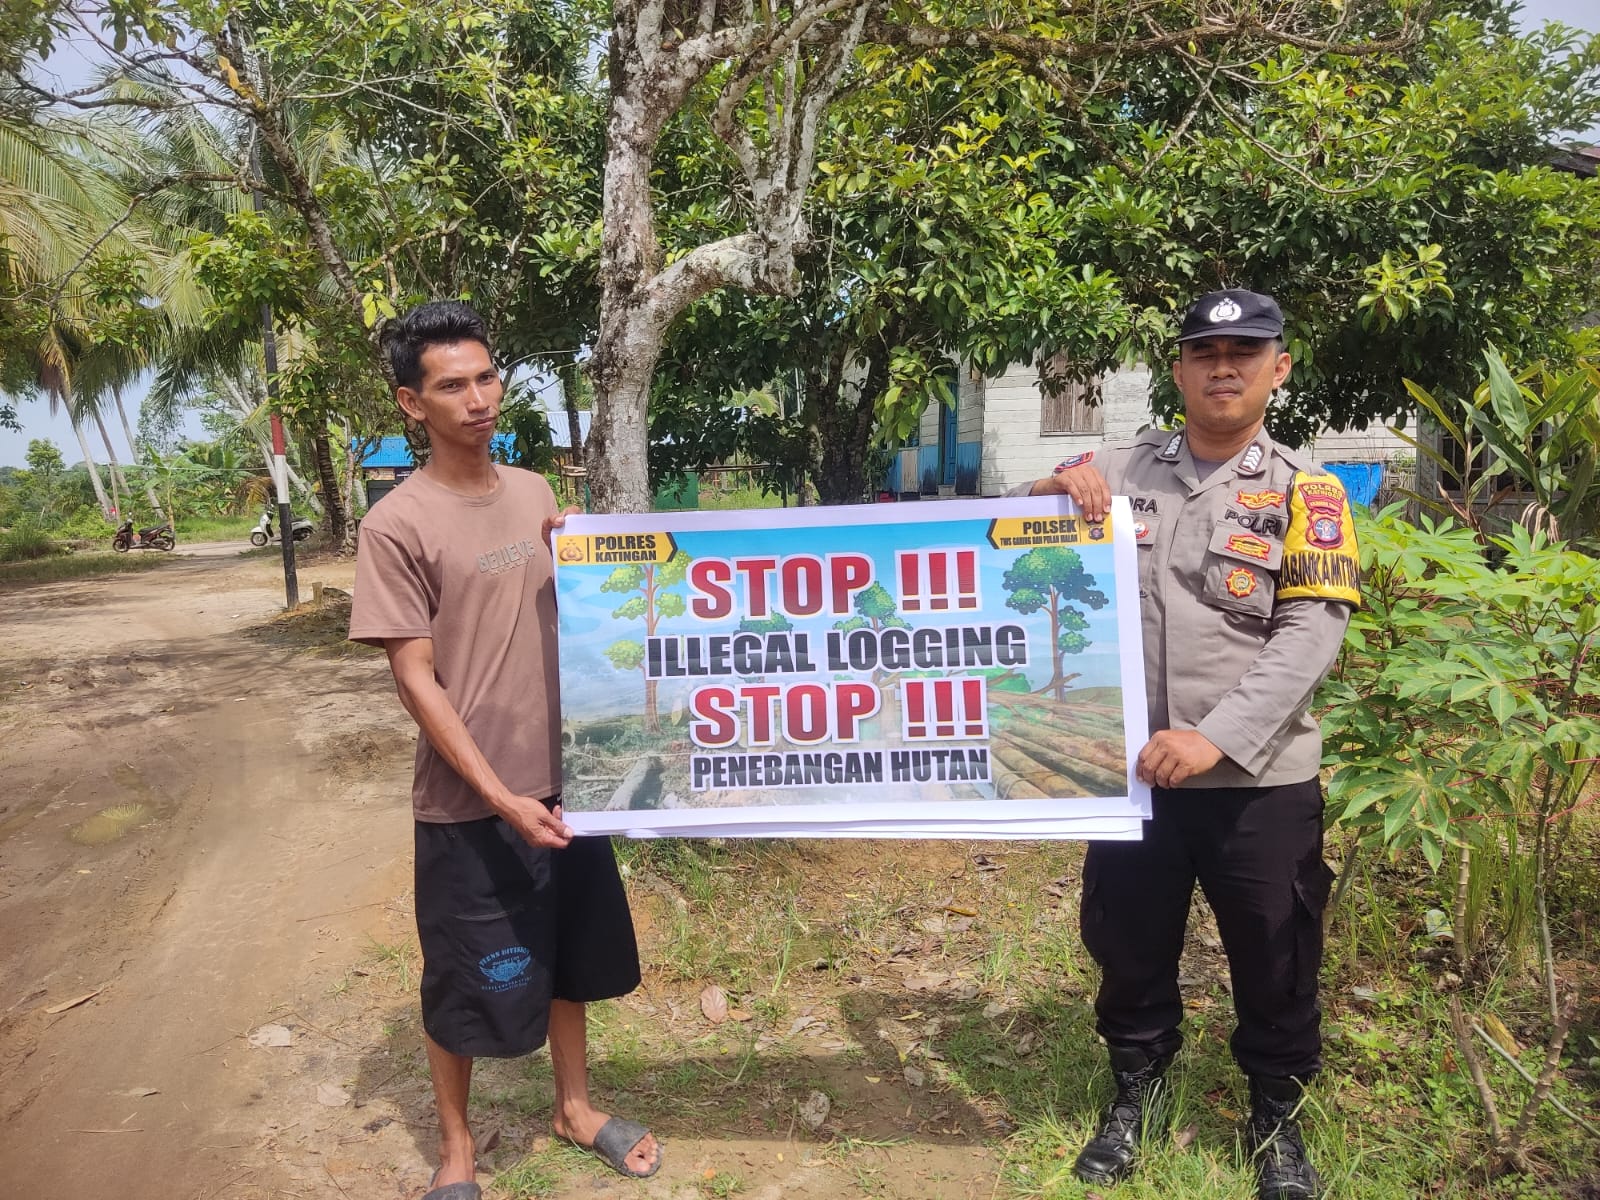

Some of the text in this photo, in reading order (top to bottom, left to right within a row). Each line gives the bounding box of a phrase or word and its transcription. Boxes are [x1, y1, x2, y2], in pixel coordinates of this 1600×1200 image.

[1023, 519, 1077, 534] POLSEK
[1225, 509, 1283, 537] POLRI
[594, 534, 656, 551] POLRES
[594, 550, 657, 563] KATINGAN
[690, 549, 978, 620] STOP !!!
[647, 625, 1028, 678] ILLEGAL LOGGING
[693, 679, 985, 745] STOP !!!
[693, 748, 989, 788] PENEBANGAN HUTAN
